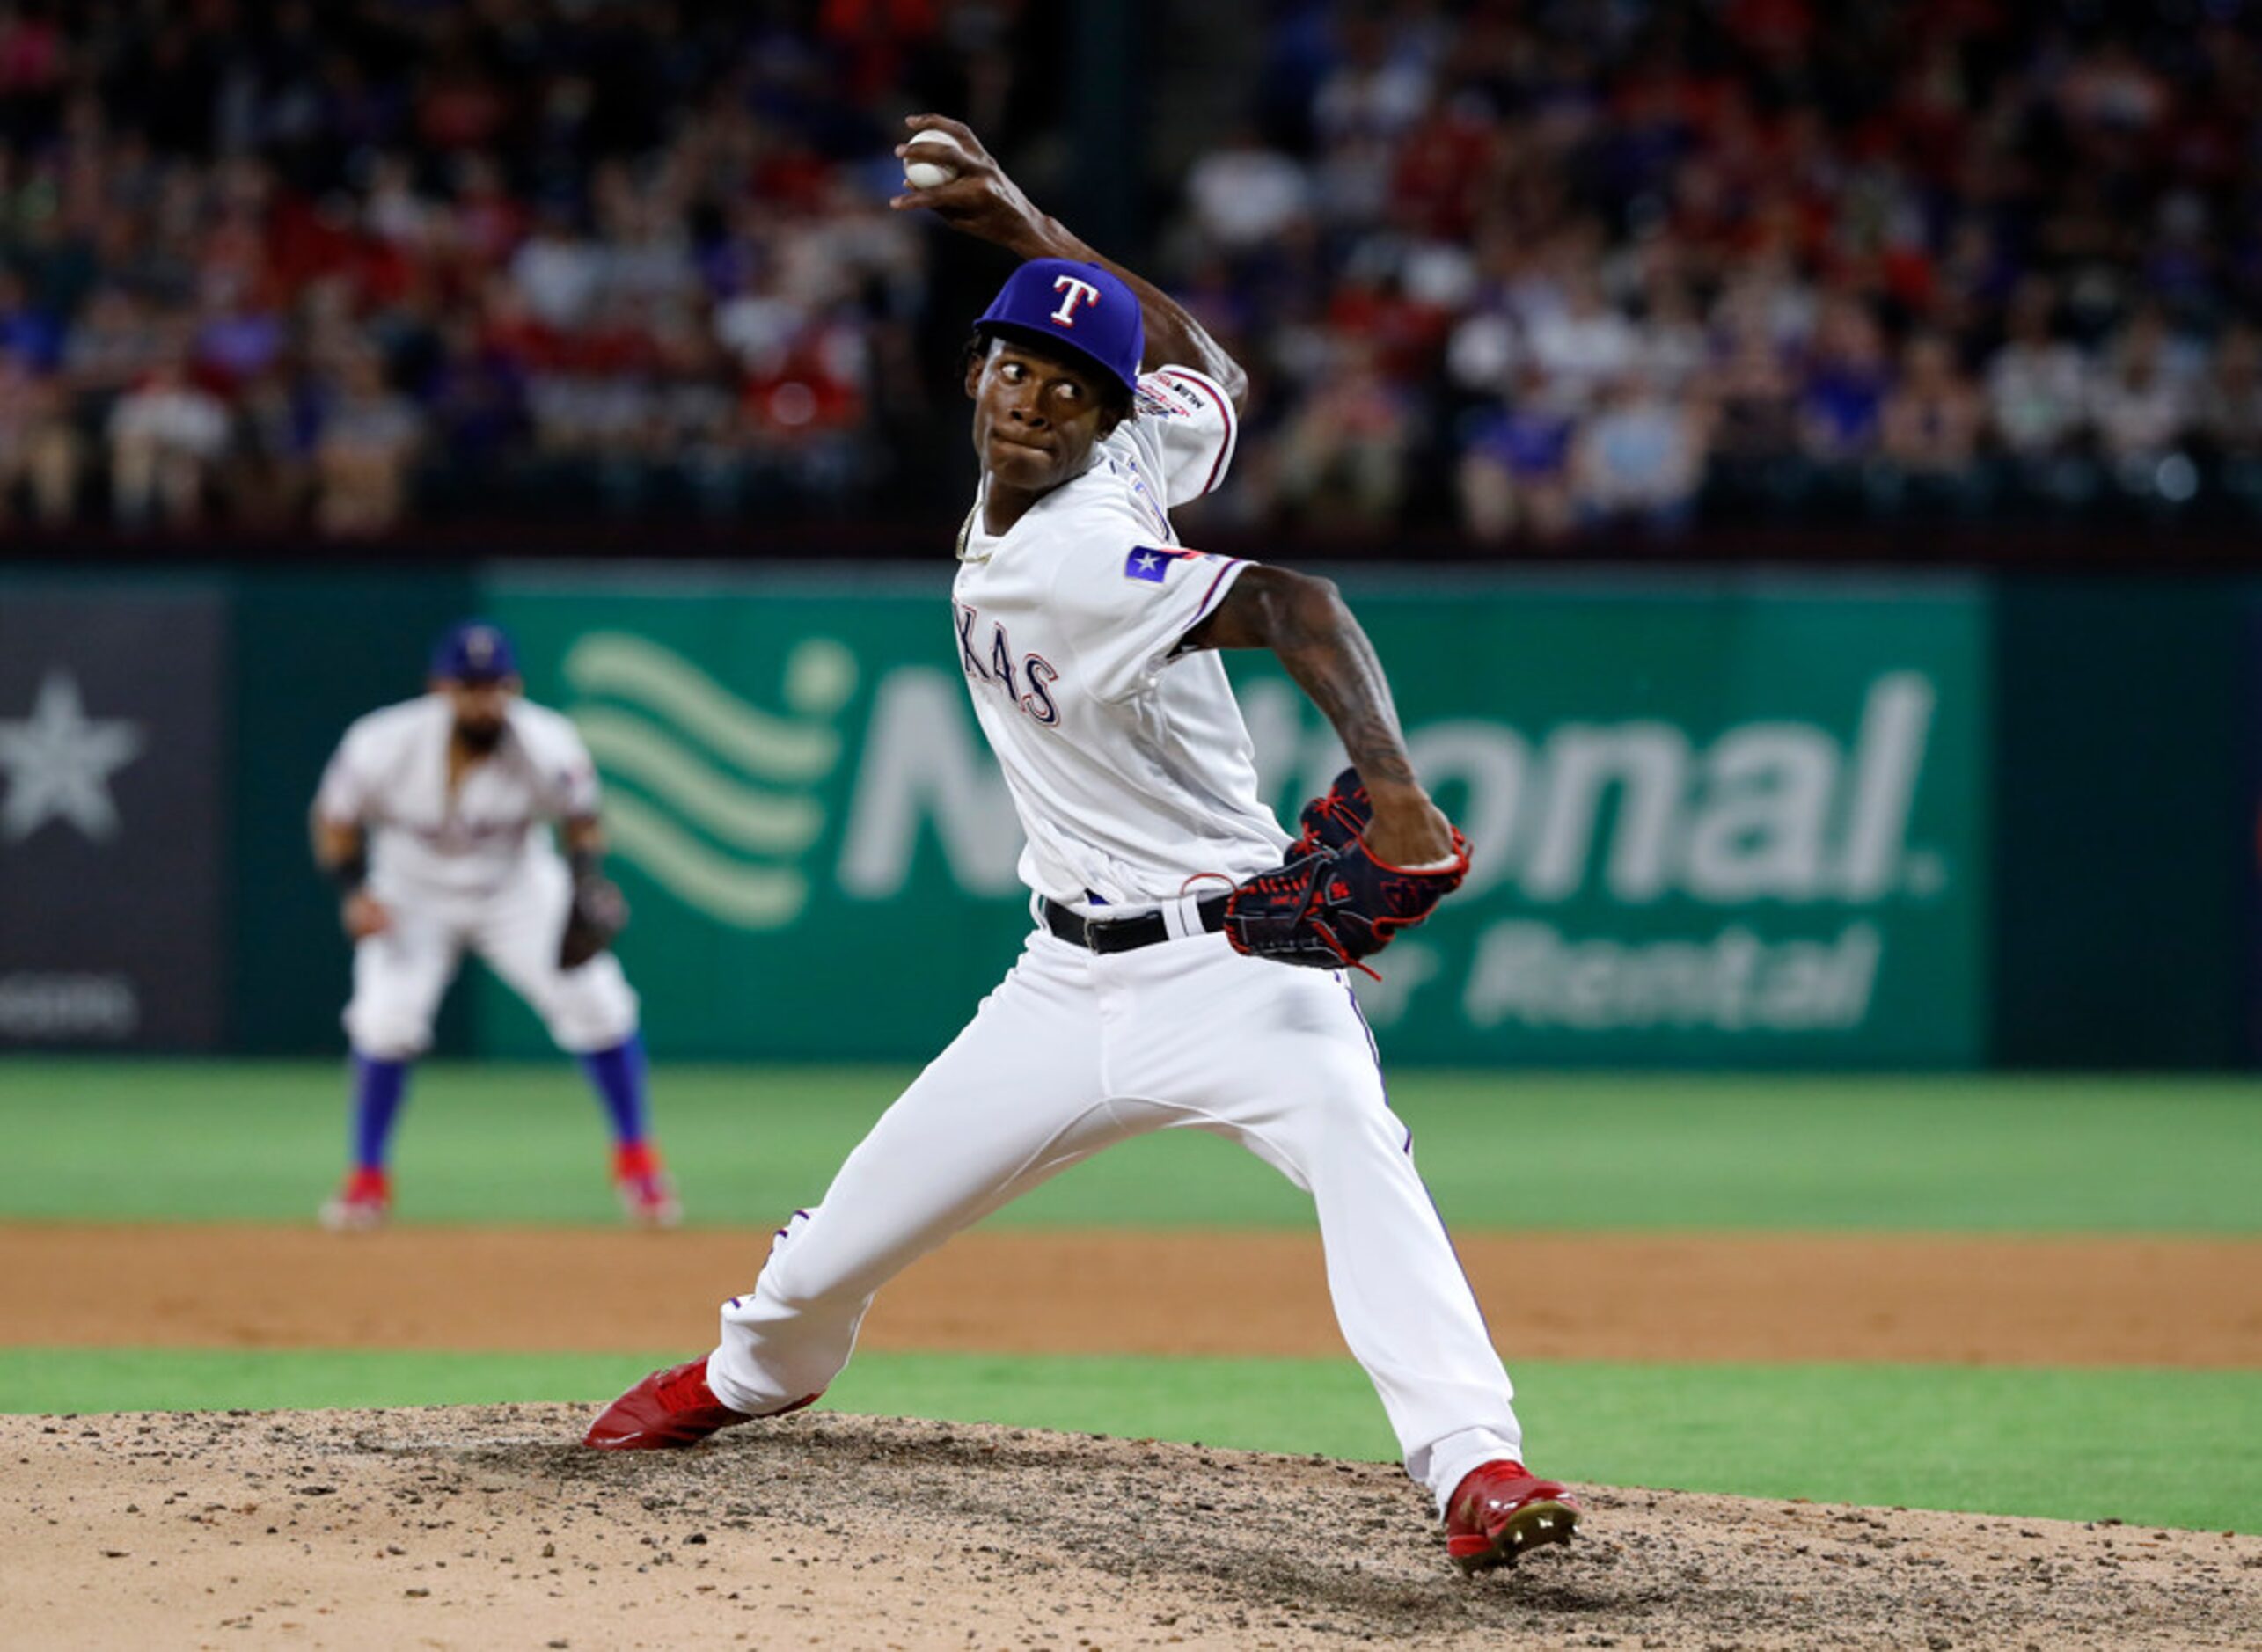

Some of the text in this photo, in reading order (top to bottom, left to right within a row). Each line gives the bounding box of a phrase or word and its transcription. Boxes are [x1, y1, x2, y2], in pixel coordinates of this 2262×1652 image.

[1050, 274, 1102, 329] T
[838, 667, 1936, 901] Ntonal
[1464, 918, 1881, 1029] Rental
